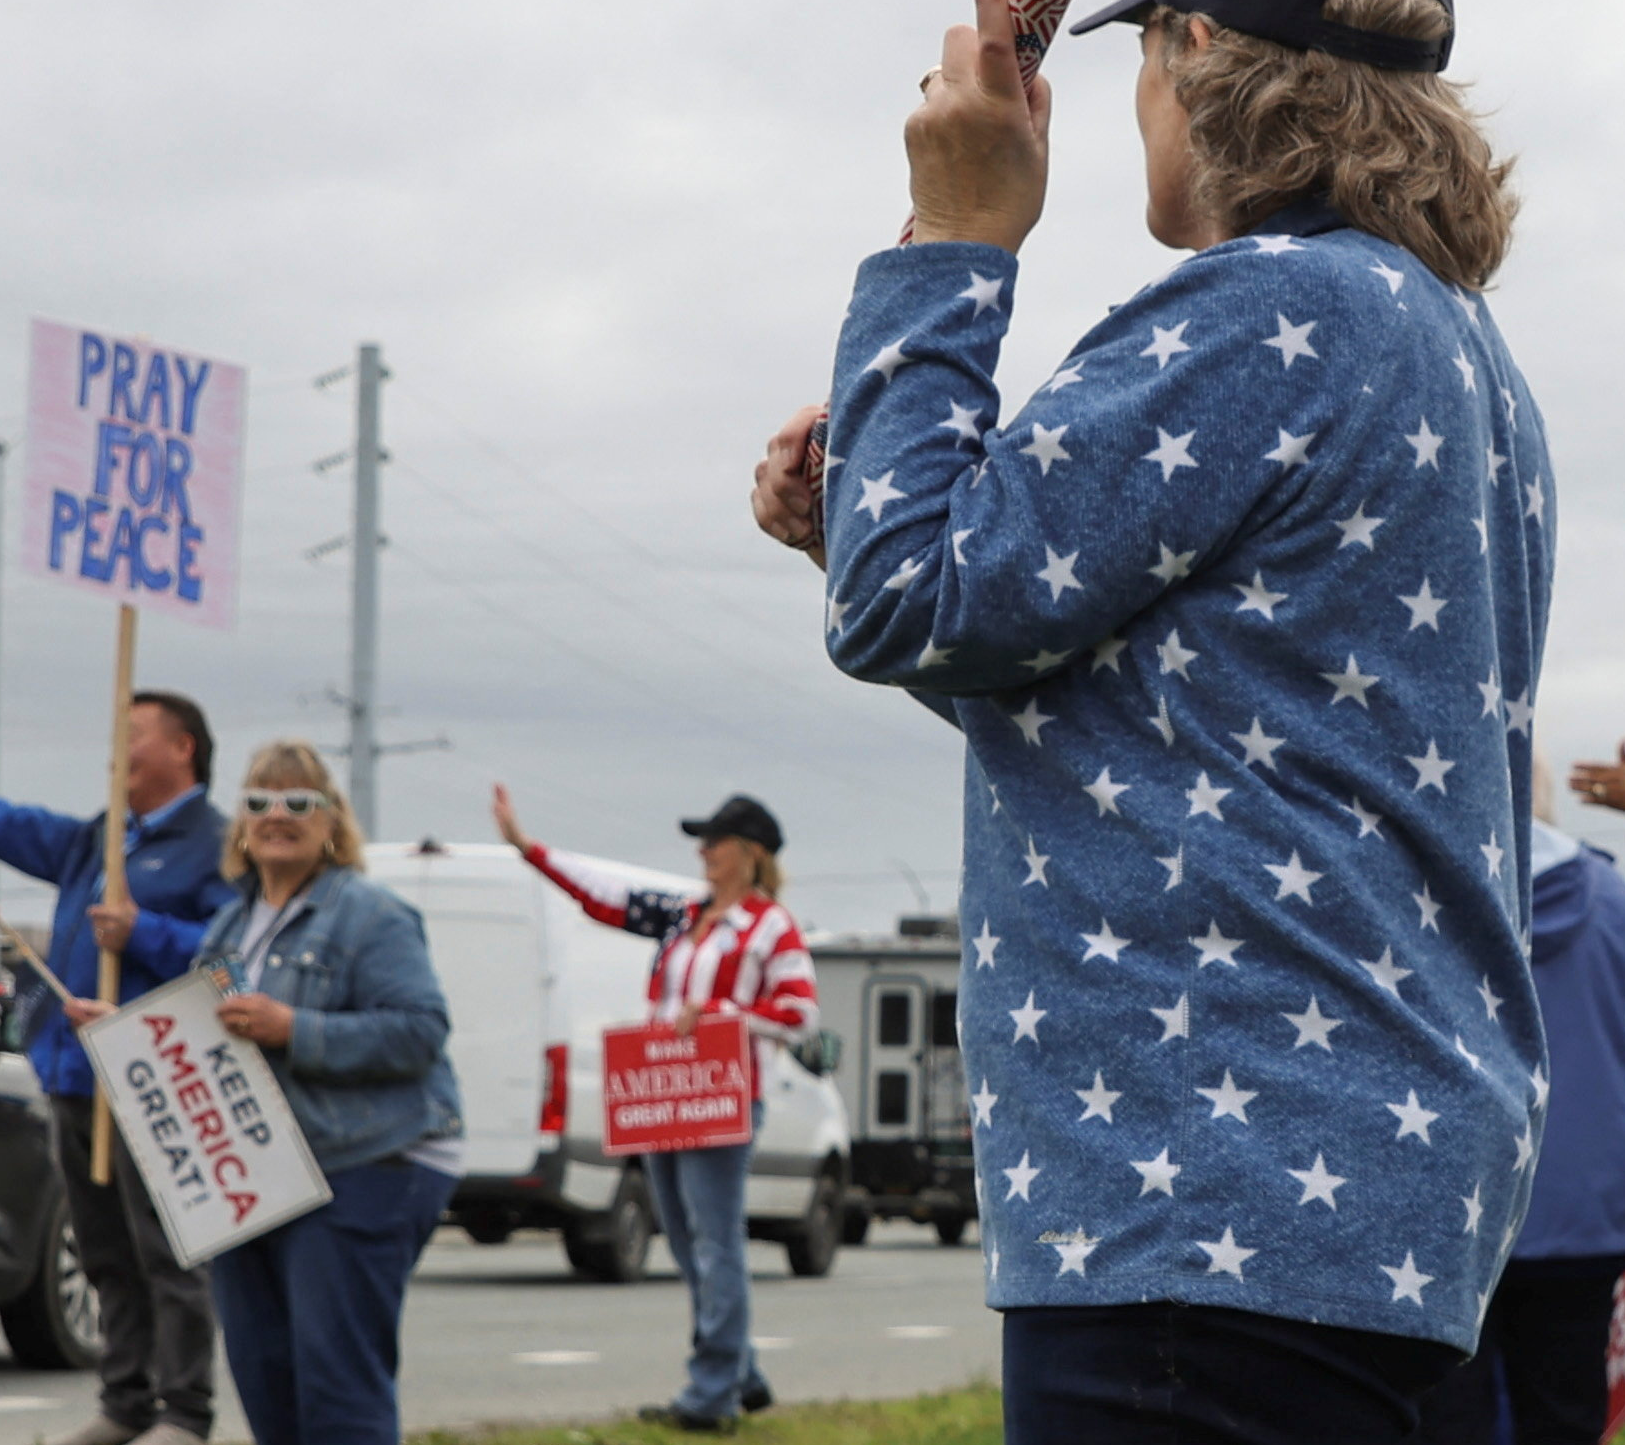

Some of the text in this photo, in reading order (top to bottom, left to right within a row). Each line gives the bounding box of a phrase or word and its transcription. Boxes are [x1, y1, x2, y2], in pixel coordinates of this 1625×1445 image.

[79, 331, 210, 435] PRAY
[94, 420, 196, 525] FOR
[48, 489, 205, 604] PEACE
[142, 1014, 261, 1225] AMERICA
[206, 1042, 272, 1146] KEEP
[607, 1059, 745, 1104] AMERICA
[127, 1060, 211, 1211] GREAT!
